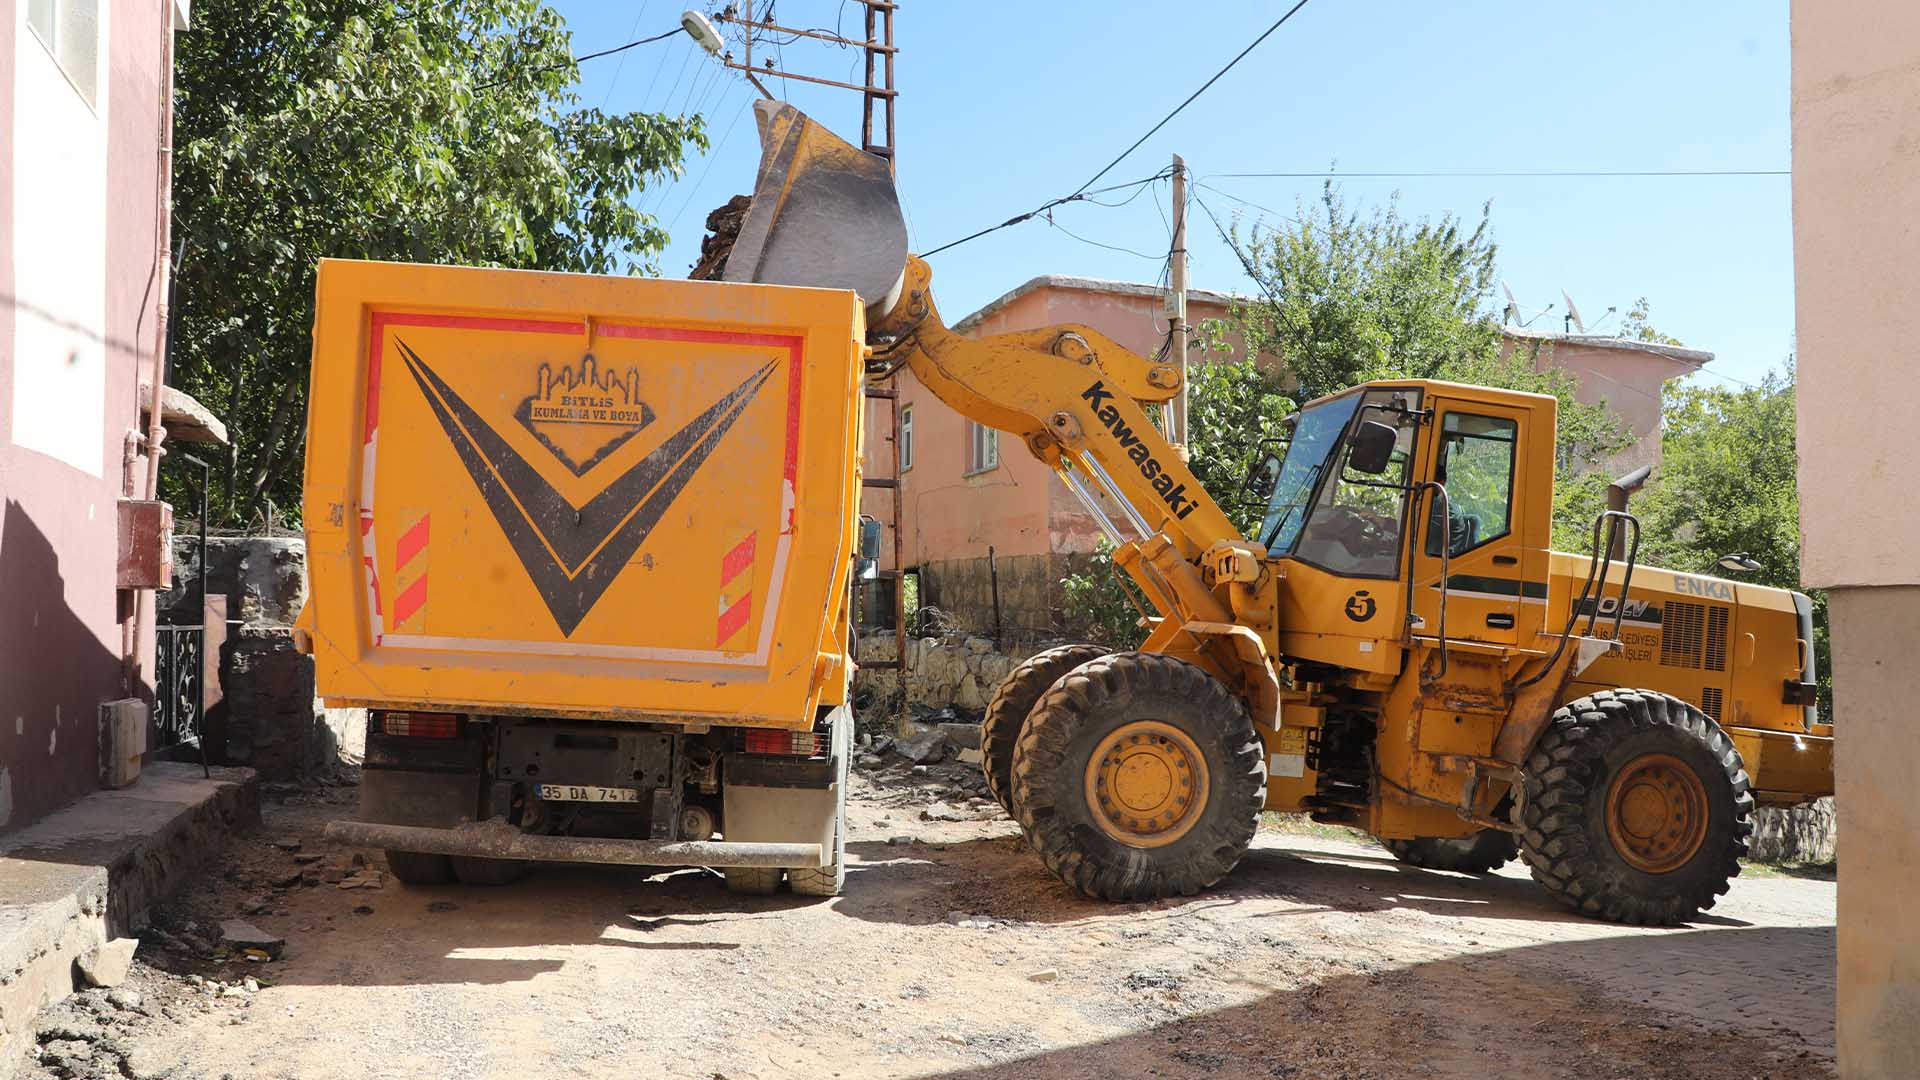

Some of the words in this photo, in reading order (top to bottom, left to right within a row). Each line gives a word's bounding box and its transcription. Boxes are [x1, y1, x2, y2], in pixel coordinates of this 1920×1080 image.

[593, 411, 607, 420] VE
[610, 412, 640, 422] BOYA
[1081, 380, 1199, 520] Kawasaki
[1674, 575, 1732, 600] ENKA
[1346, 592, 1373, 621] 5
[543, 786, 561, 798] 35
[570, 787, 588, 800] DA
